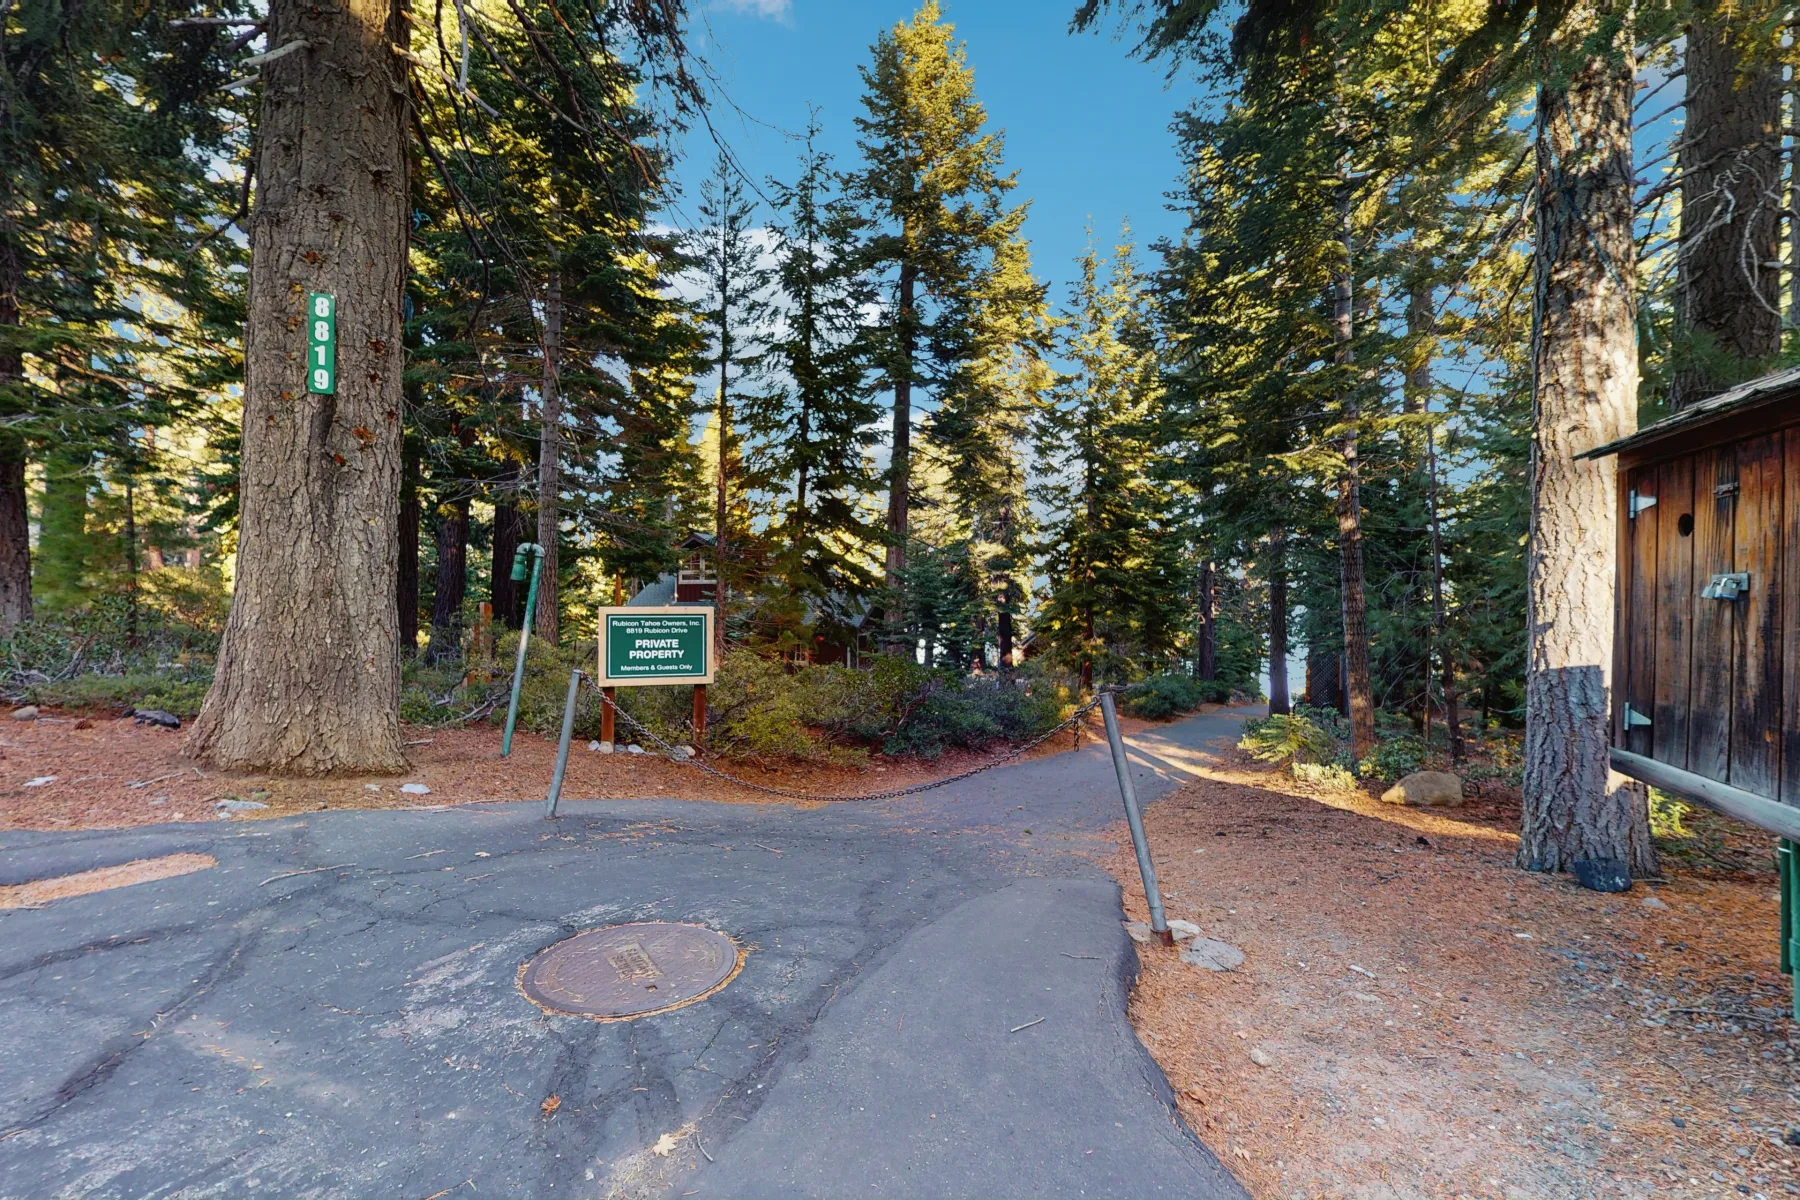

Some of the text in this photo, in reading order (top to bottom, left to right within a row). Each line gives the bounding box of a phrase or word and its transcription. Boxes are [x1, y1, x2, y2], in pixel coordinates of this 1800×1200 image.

[314, 297, 330, 390] 8819
[635, 639, 679, 649] PRIVATE
[629, 650, 684, 659] PROPERTY
